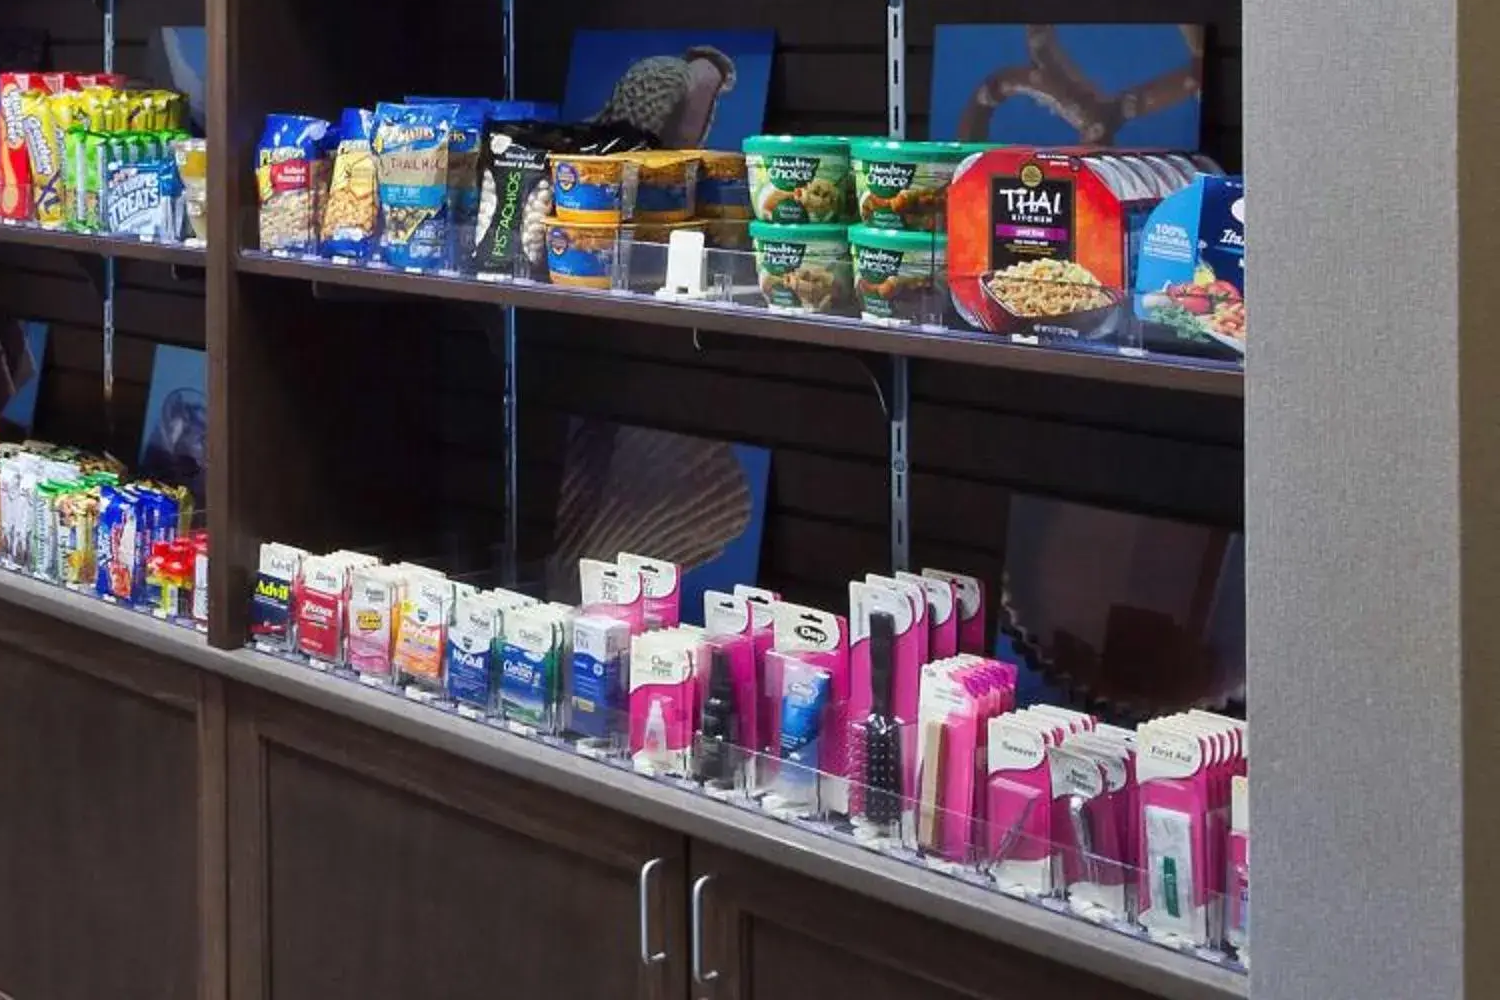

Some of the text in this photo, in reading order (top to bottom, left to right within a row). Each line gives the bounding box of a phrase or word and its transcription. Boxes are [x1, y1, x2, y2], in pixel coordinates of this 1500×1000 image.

[108, 189, 160, 223] TREATS
[491, 171, 522, 257] PISTACHIOS
[1000, 189, 1062, 216] THAI
[256, 580, 289, 601] Advil
[1151, 745, 1174, 760] First
